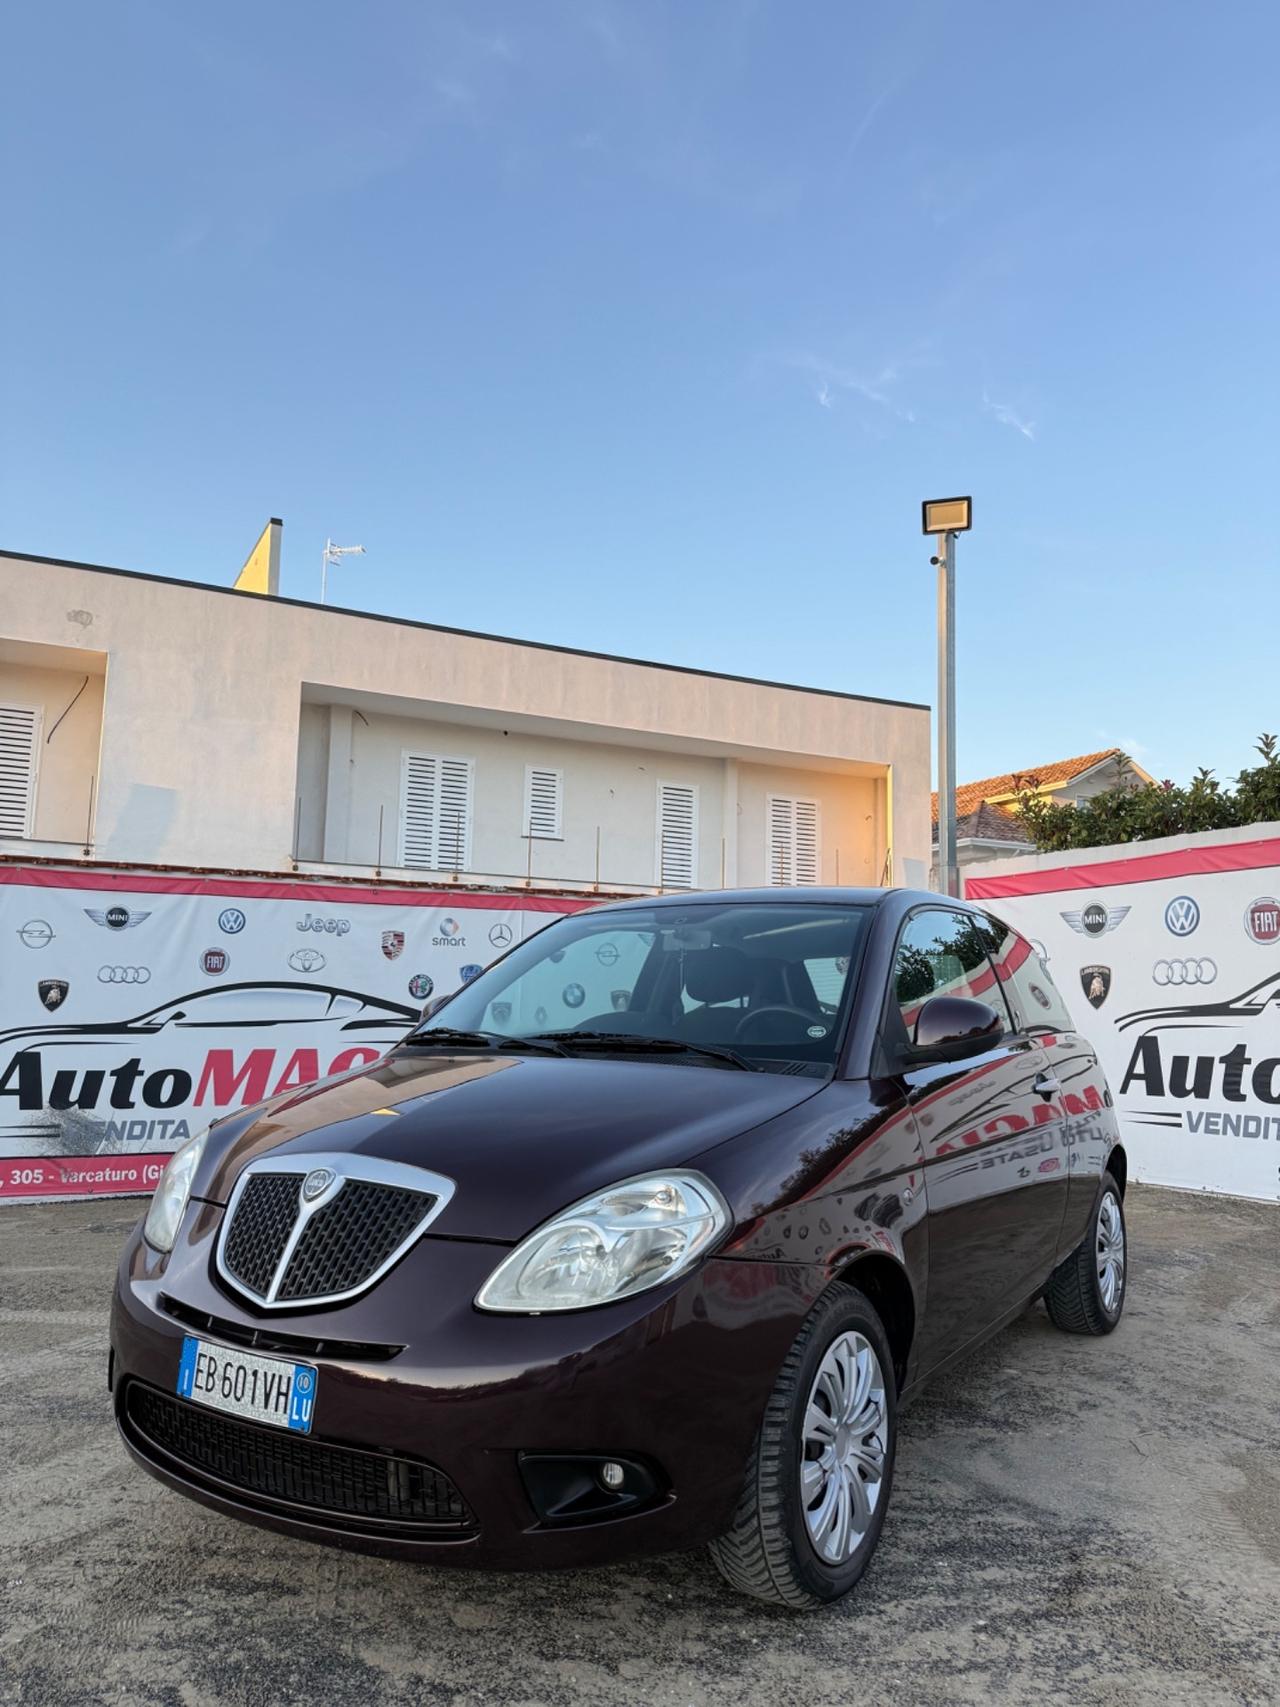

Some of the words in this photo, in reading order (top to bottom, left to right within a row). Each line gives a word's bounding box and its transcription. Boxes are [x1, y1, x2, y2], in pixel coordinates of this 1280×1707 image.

[296, 914, 351, 937] Jeep
[1084, 914, 1105, 925] MINI
[1254, 911, 1279, 932] FIAT
[432, 937, 466, 947] smart
[207, 956, 224, 969] FIAT
[10, 1169, 44, 1185] 305
[61, 1167, 138, 1184] Varcaturo
[291, 1396, 312, 1423] LU
